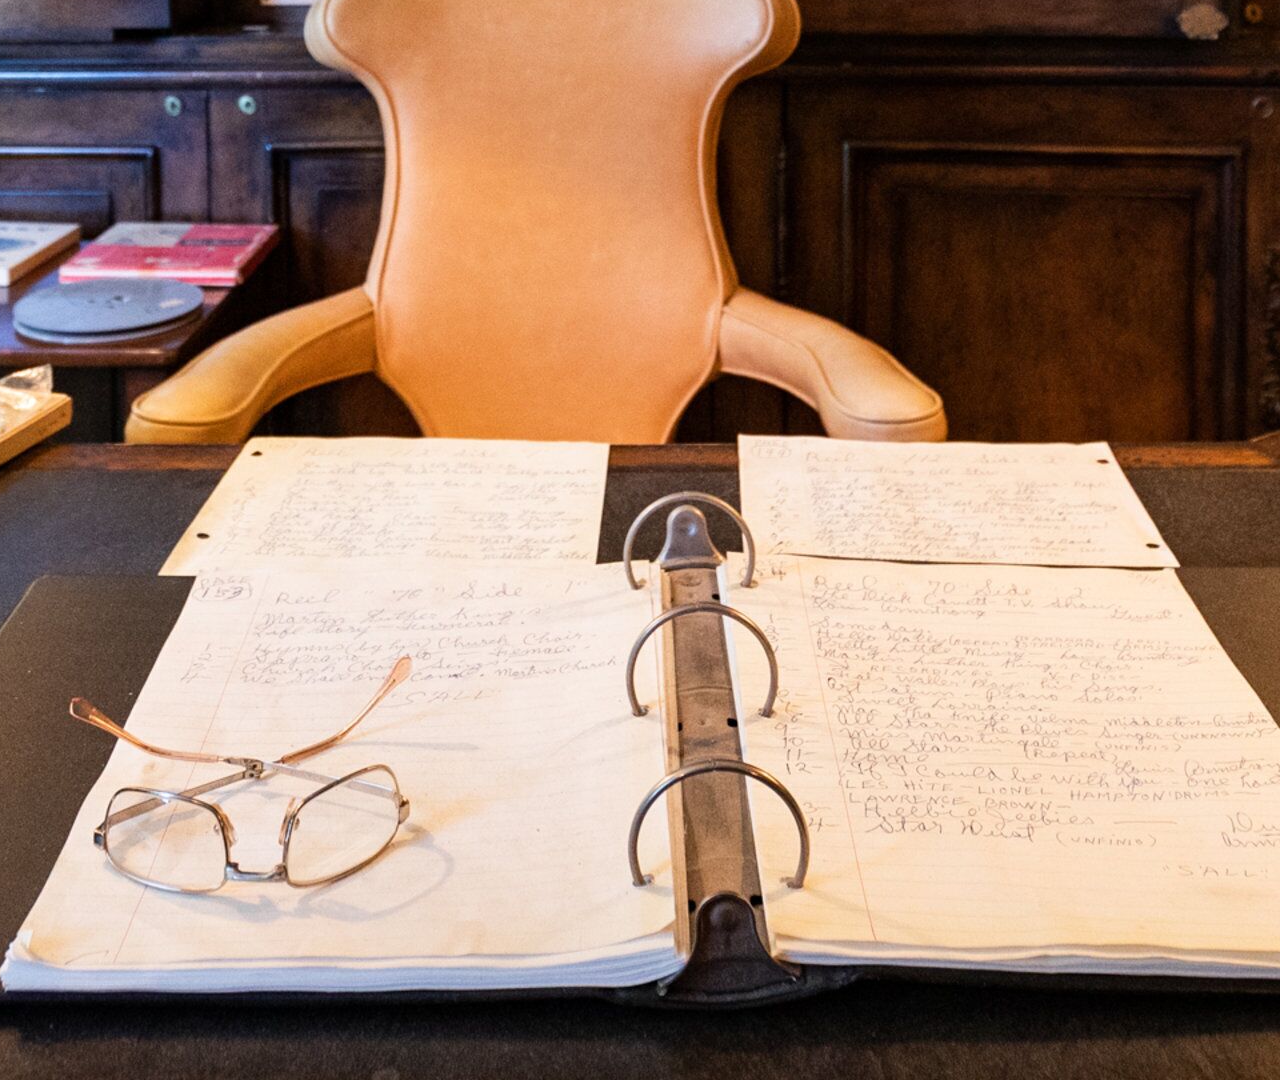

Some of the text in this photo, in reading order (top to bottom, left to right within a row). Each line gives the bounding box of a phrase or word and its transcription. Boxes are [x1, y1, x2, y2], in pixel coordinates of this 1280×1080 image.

[455, 580, 522, 600] Side
[814, 575, 878, 590] Reel
[972, 579, 1032, 596] Side
[842, 749, 929, 763] Home
[846, 780, 888, 789] LES
[1069, 789, 1165, 802] HAMPTON
[849, 792, 1053, 811] LAWRENCE BROWN
